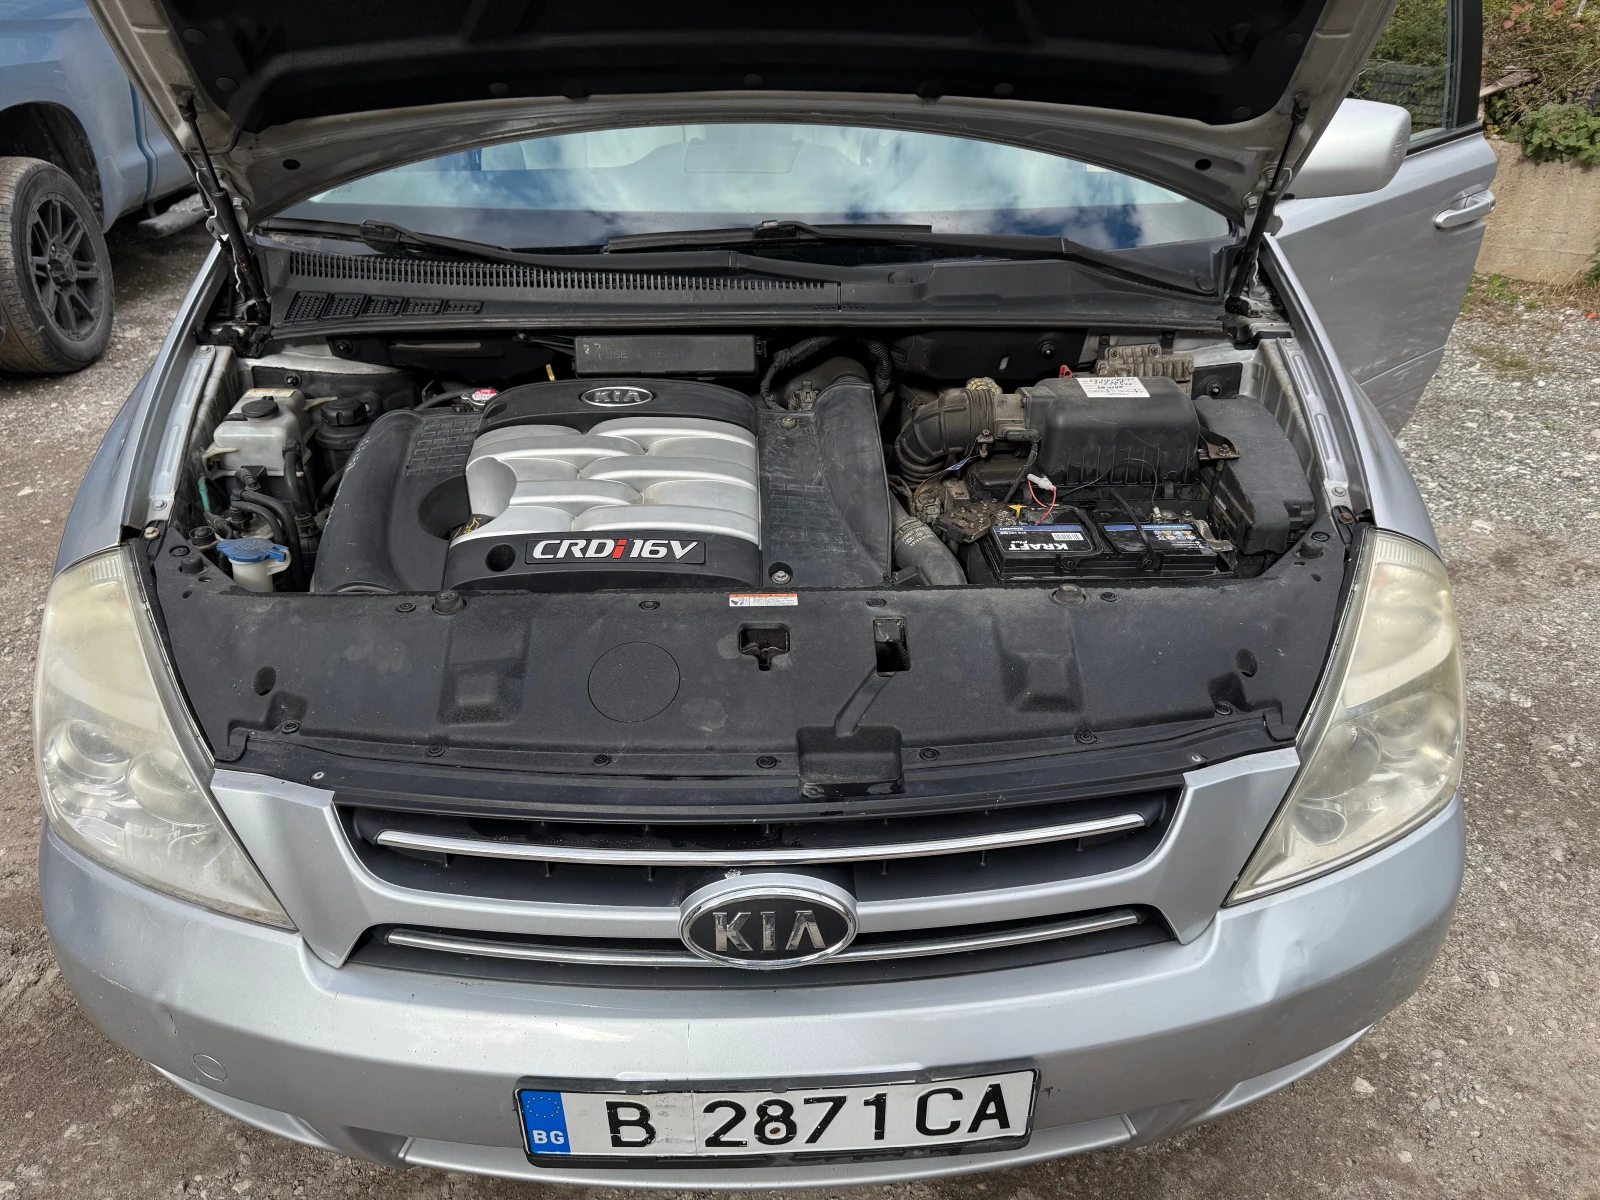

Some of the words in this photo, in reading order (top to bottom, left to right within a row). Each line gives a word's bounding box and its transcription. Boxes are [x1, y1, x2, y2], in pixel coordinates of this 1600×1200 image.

[599, 349, 628, 359] FUSE
[594, 390, 641, 402] KIA
[629, 539, 698, 560] 16V
[1008, 543, 1069, 551] KRAFT
[712, 910, 827, 953] KIA
[606, 1101, 656, 1148] B
[702, 1092, 887, 1148] 2871
[914, 1083, 1011, 1137] CA
[533, 1130, 565, 1145] BG
